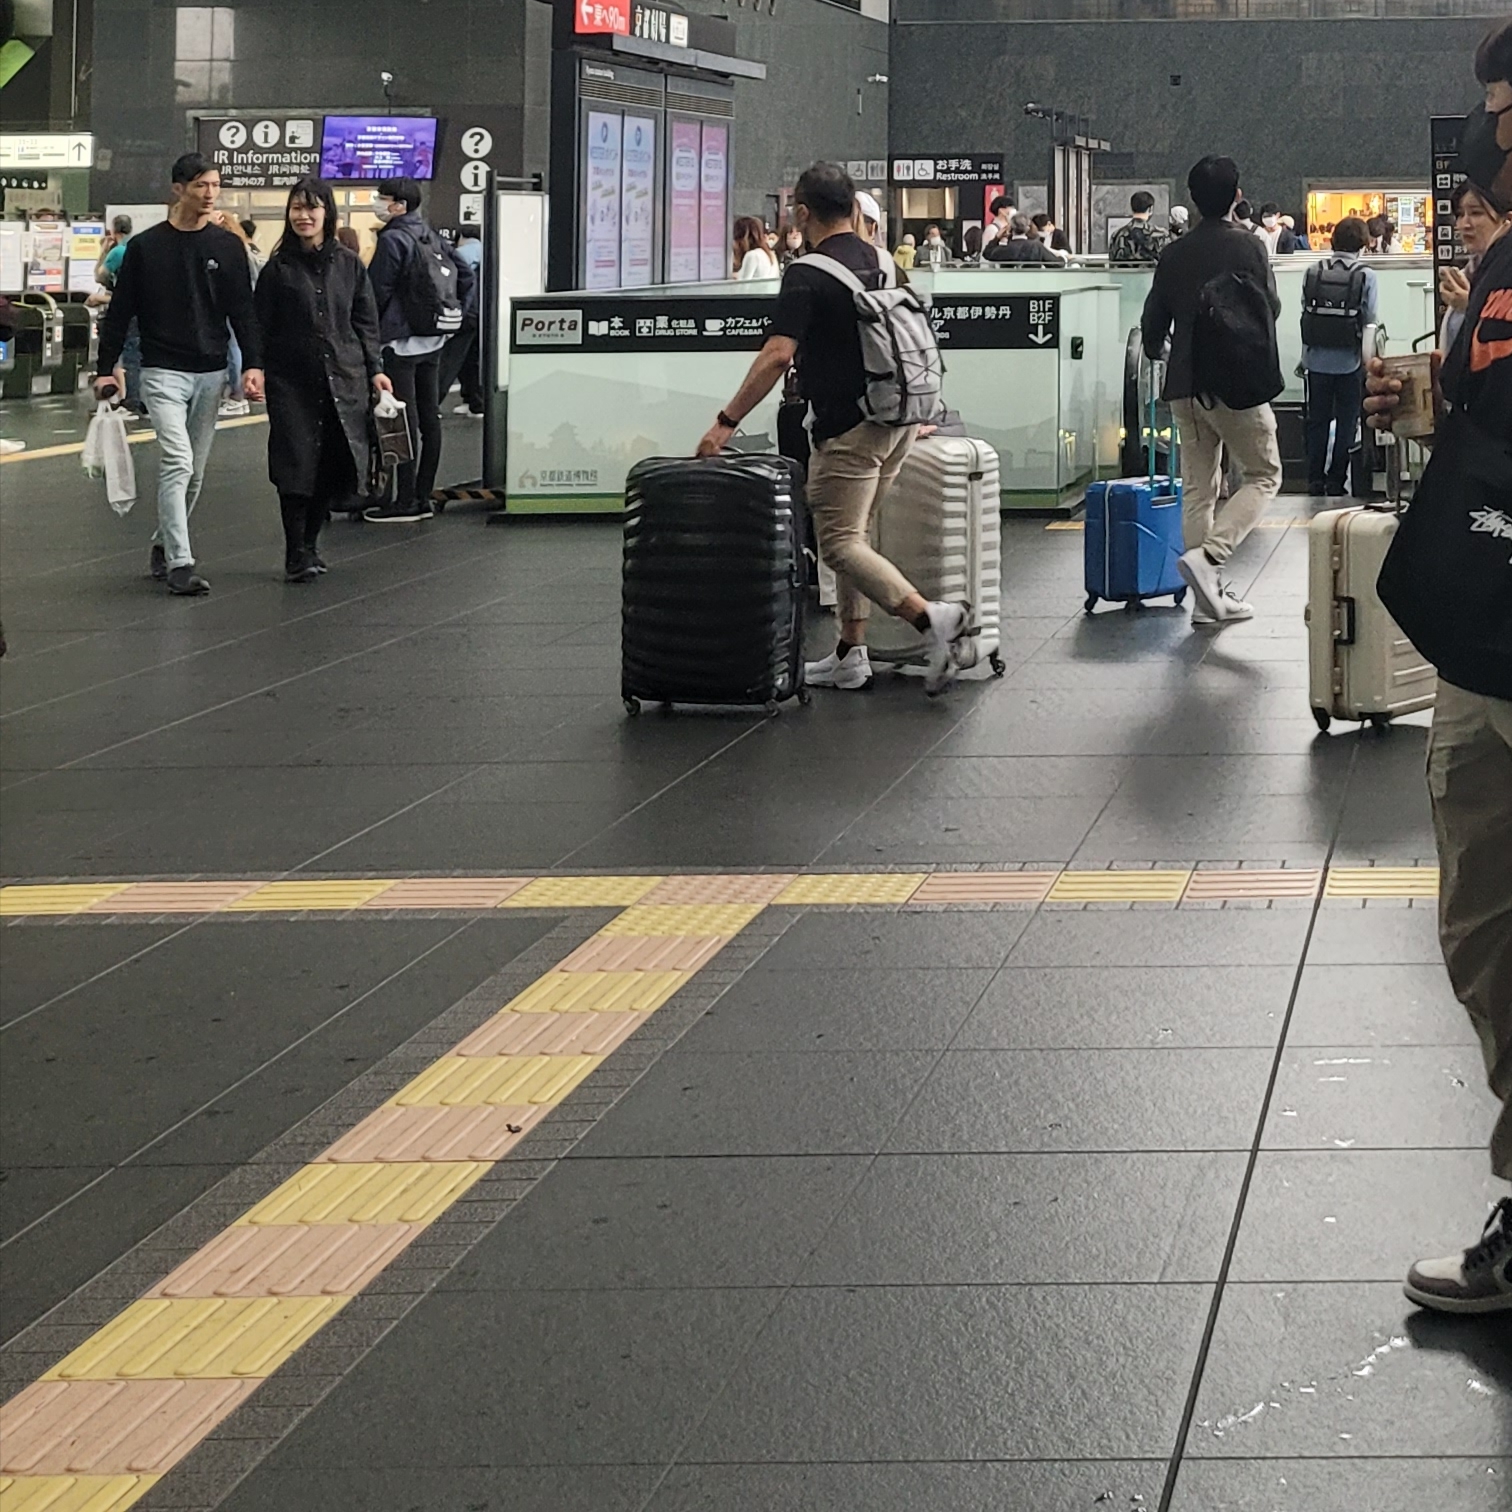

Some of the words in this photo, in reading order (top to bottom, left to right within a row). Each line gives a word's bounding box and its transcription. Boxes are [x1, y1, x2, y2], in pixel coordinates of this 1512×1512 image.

[233, 150, 320, 164] Information
[935, 159, 972, 170] お手洗
[936, 172, 978, 180] Restroom
[1029, 300, 1053, 312] B1F
[610, 316, 624, 328] 本
[1029, 312, 1053, 324] B2F
[520, 317, 578, 332] Porta
